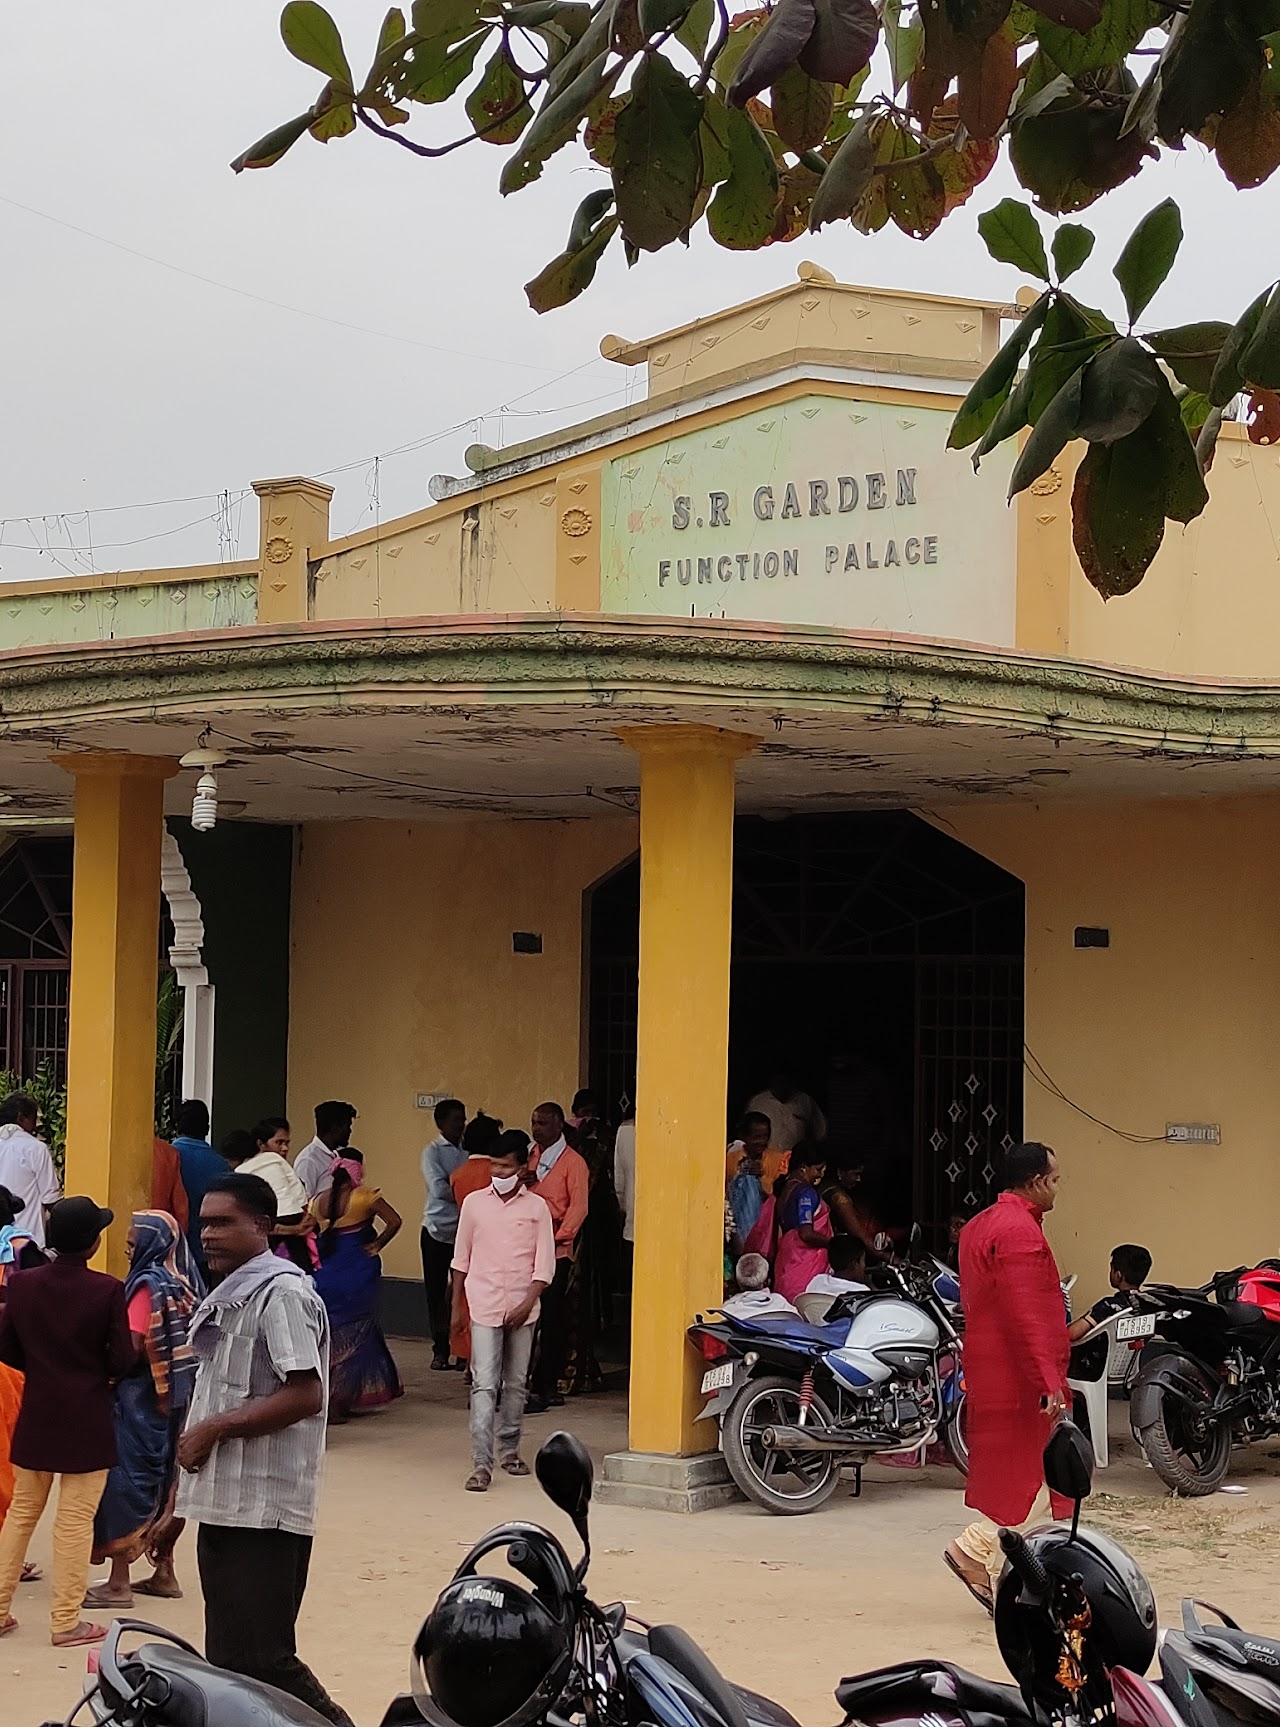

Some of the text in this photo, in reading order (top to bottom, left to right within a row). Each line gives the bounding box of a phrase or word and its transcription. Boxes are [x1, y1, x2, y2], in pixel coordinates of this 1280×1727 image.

[672, 468, 918, 530] S.R GARDEN
[659, 535, 939, 588] FUNCTION PALACE
[458, 1584, 505, 1609] Wrangler
